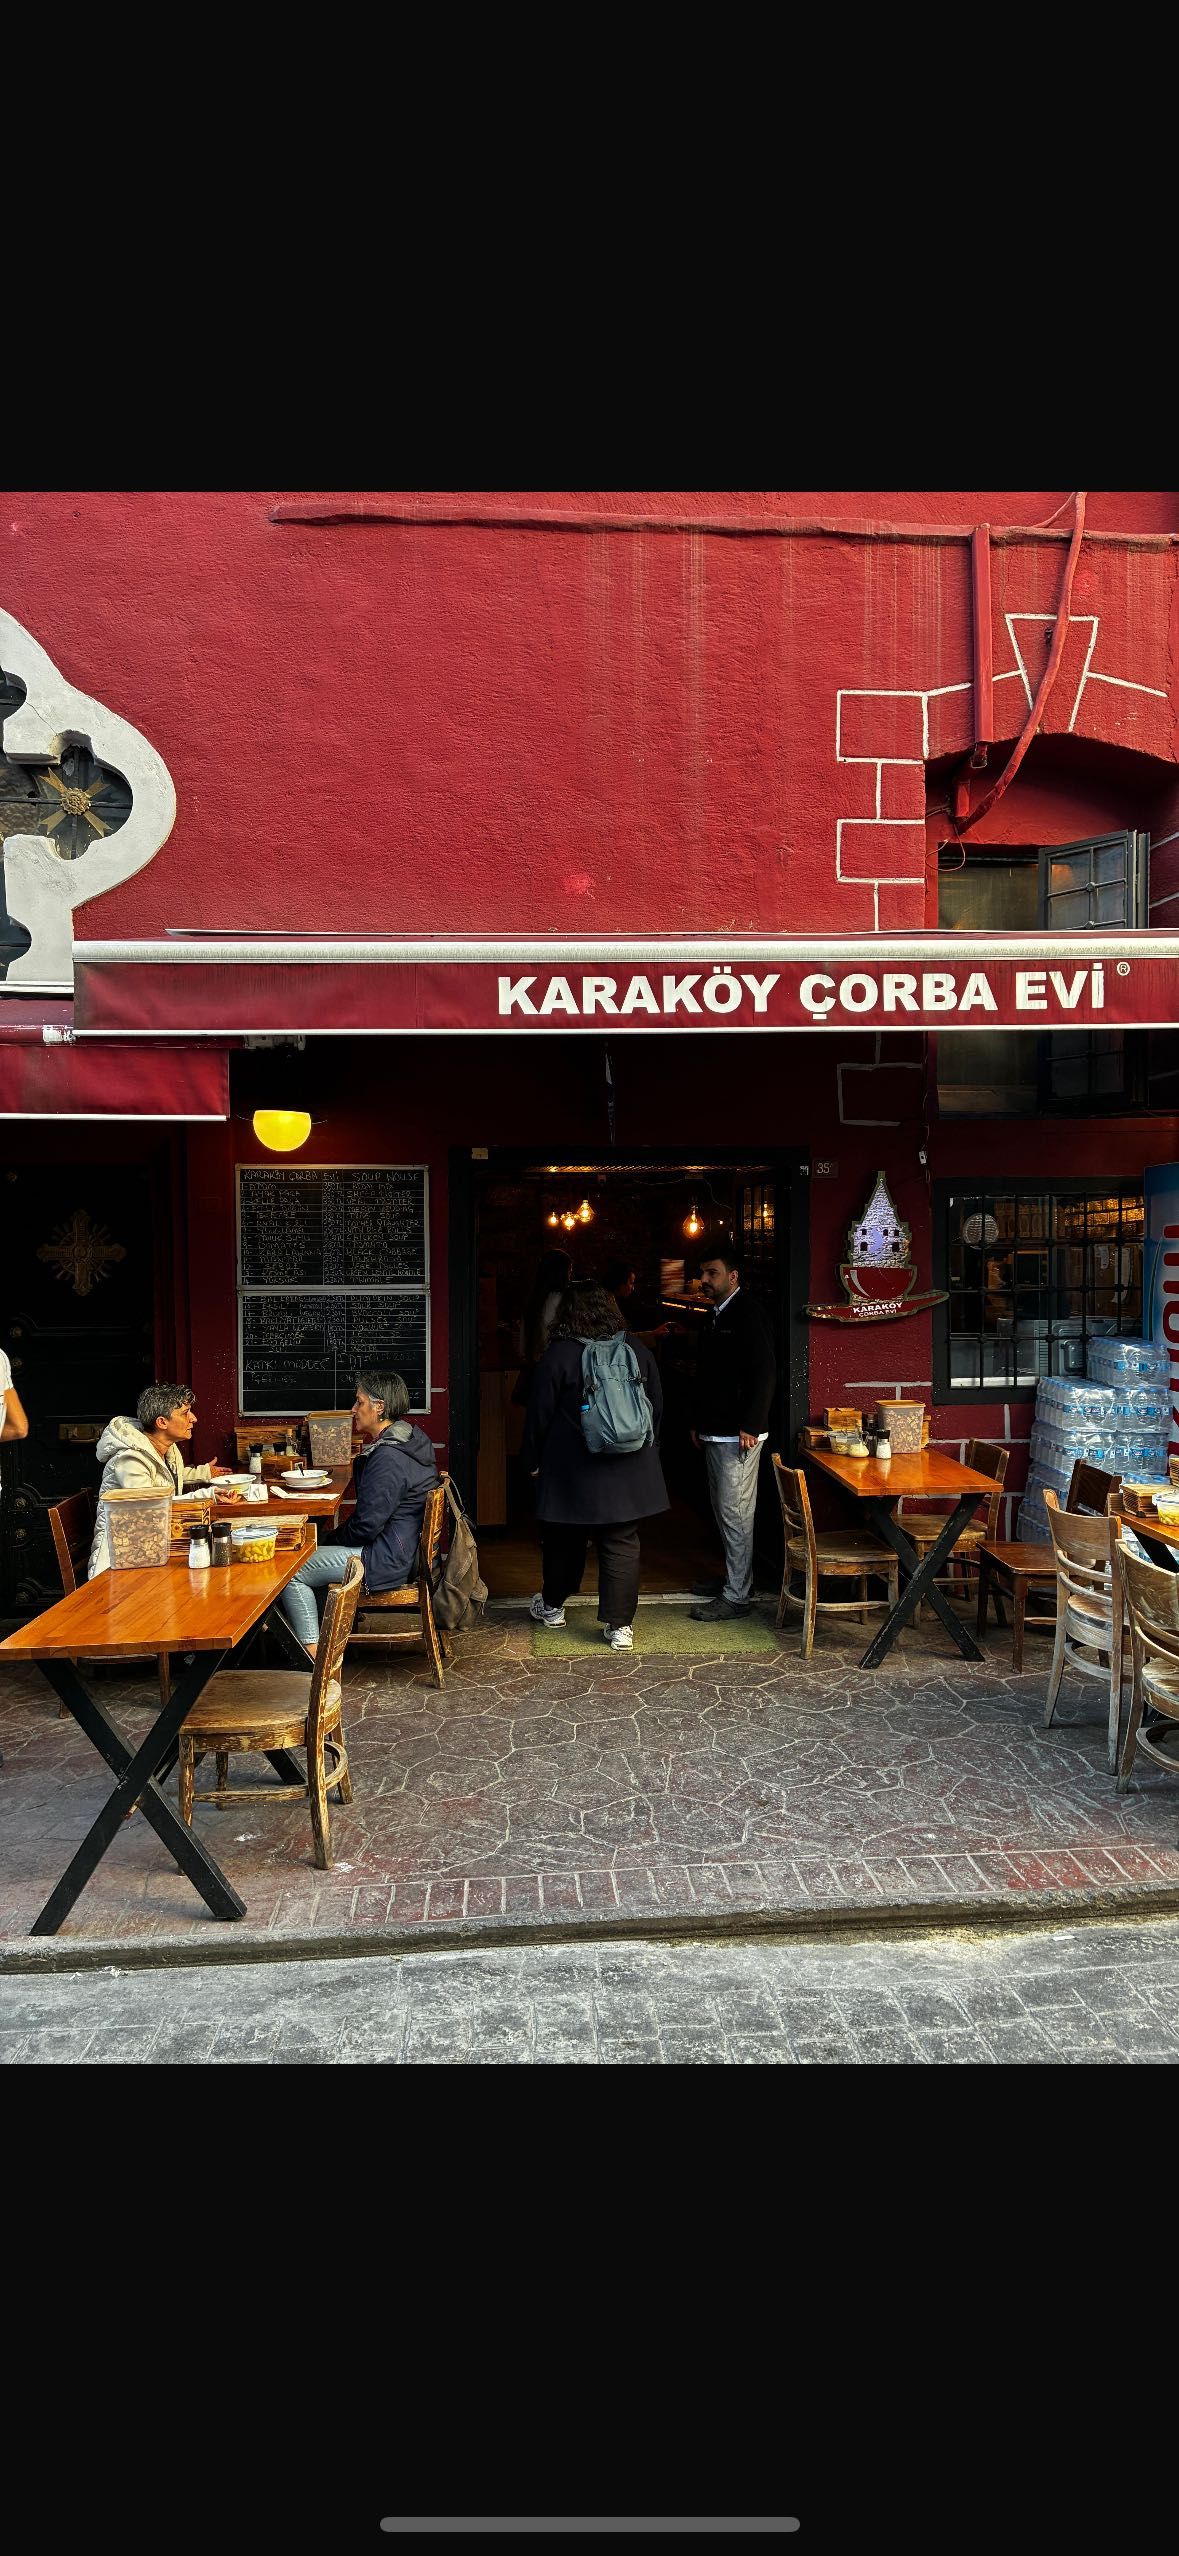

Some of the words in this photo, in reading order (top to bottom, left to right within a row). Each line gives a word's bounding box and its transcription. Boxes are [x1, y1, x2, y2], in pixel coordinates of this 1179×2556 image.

[498, 966, 780, 1015] KARAKÖY
[799, 973, 998, 1020] ÇORBA
[1015, 962, 1105, 1010] EVİ
